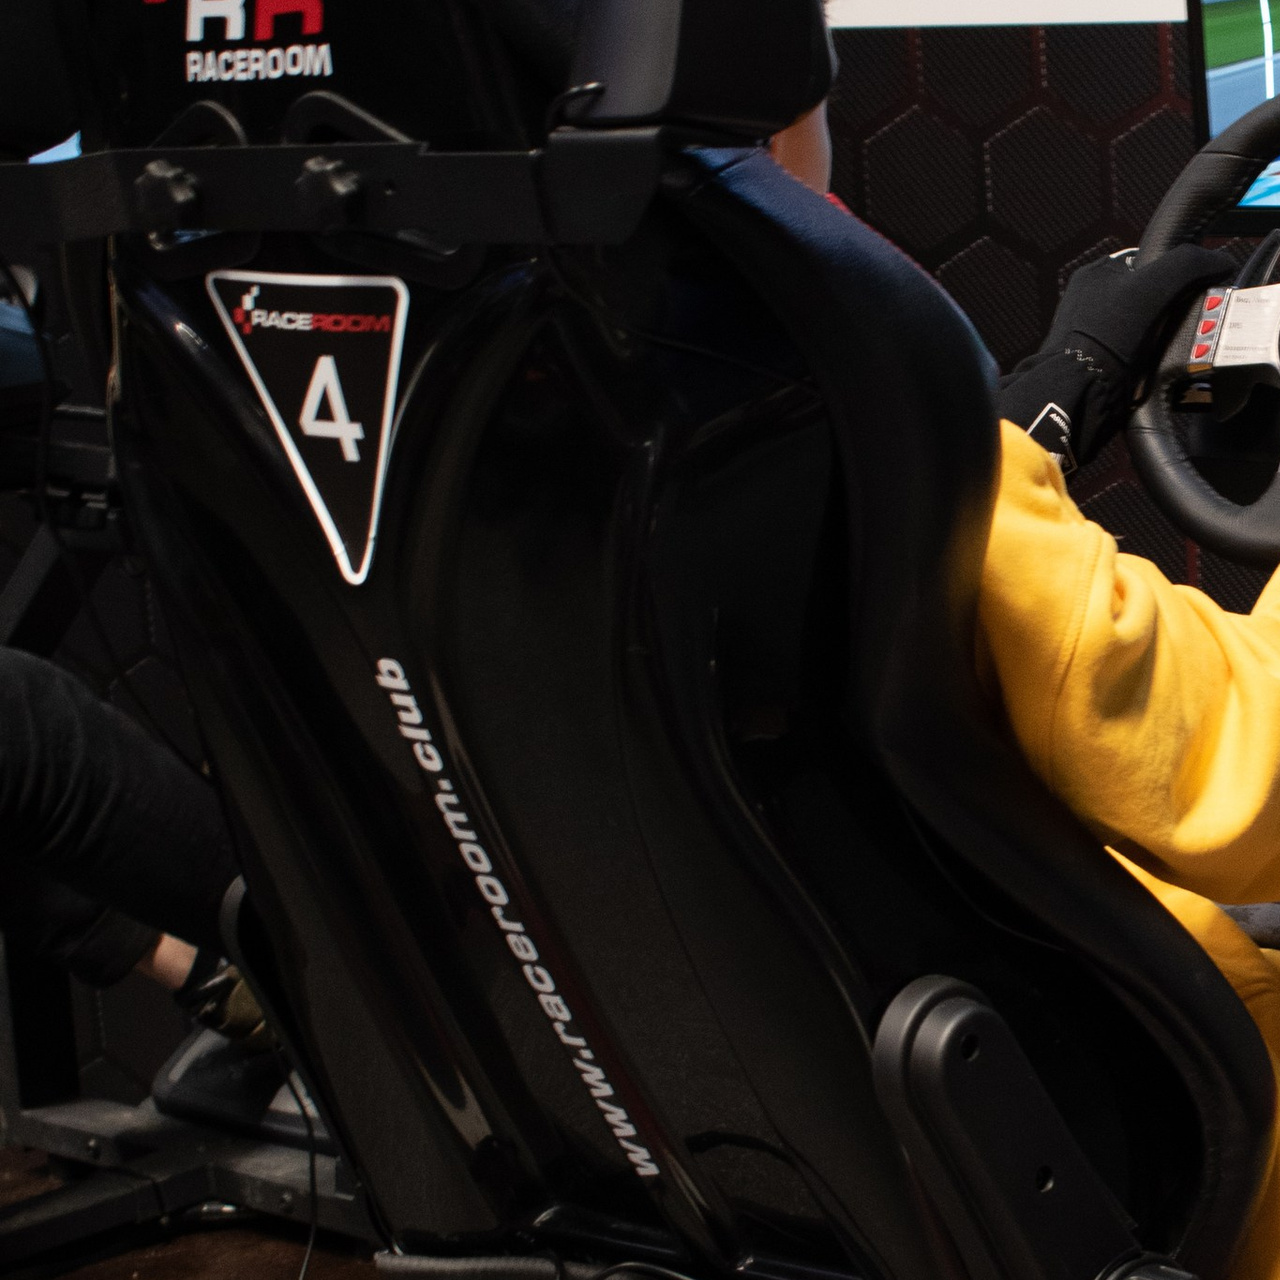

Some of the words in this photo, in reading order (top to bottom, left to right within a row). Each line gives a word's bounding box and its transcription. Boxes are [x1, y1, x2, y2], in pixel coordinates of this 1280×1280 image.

[186, 43, 333, 83] RACEROOM
[251, 309, 391, 333] RACEROOM
[300, 355, 365, 462] 4
